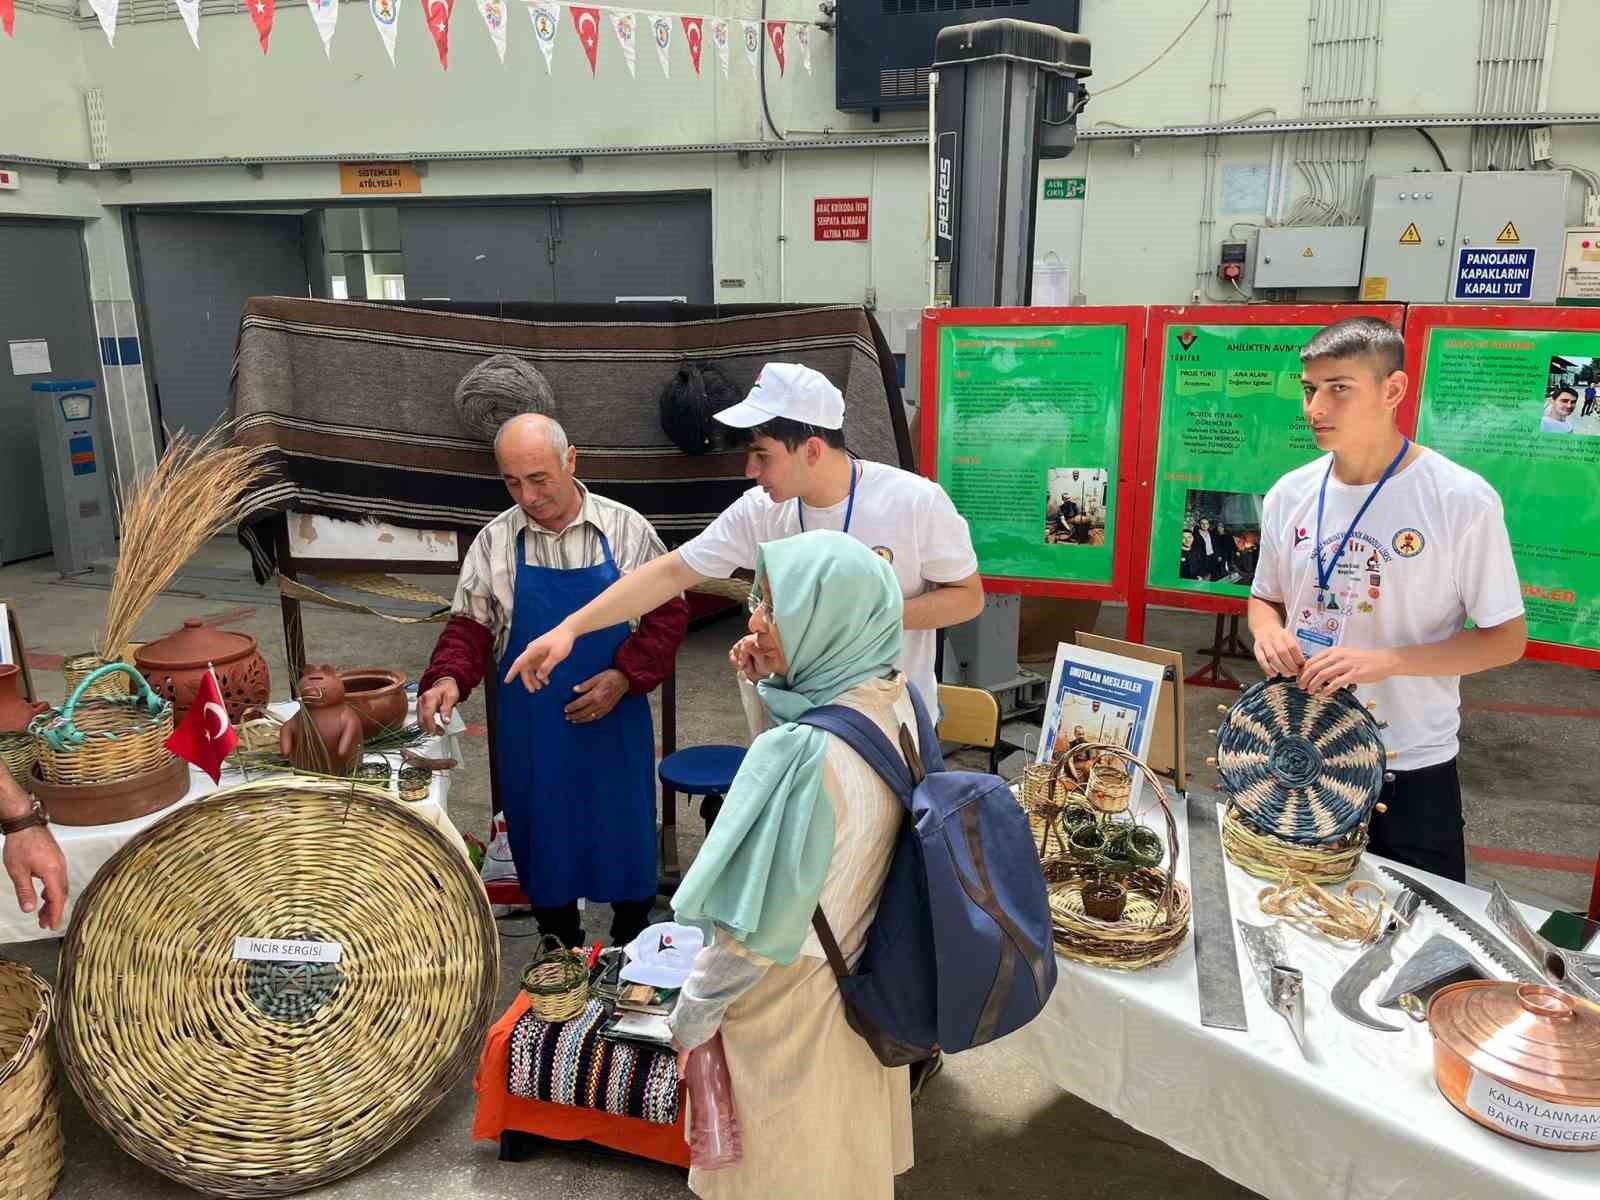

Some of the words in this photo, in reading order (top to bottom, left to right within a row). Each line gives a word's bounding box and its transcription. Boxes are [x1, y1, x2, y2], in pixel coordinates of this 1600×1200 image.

[1466, 253, 1527, 265] PANOLARIN
[1460, 268, 1529, 280] KAPAKLARINI
[1464, 283, 1501, 294] KAPALI
[1503, 283, 1523, 294] TUT
[1227, 342, 1271, 353] AHİLİKTEN
[1102, 674, 1143, 693] MESLEKLER
[249, 941, 279, 954] İNCİR
[281, 945, 322, 956] SERGİSİ
[1487, 1105, 1529, 1132] BAKIR
